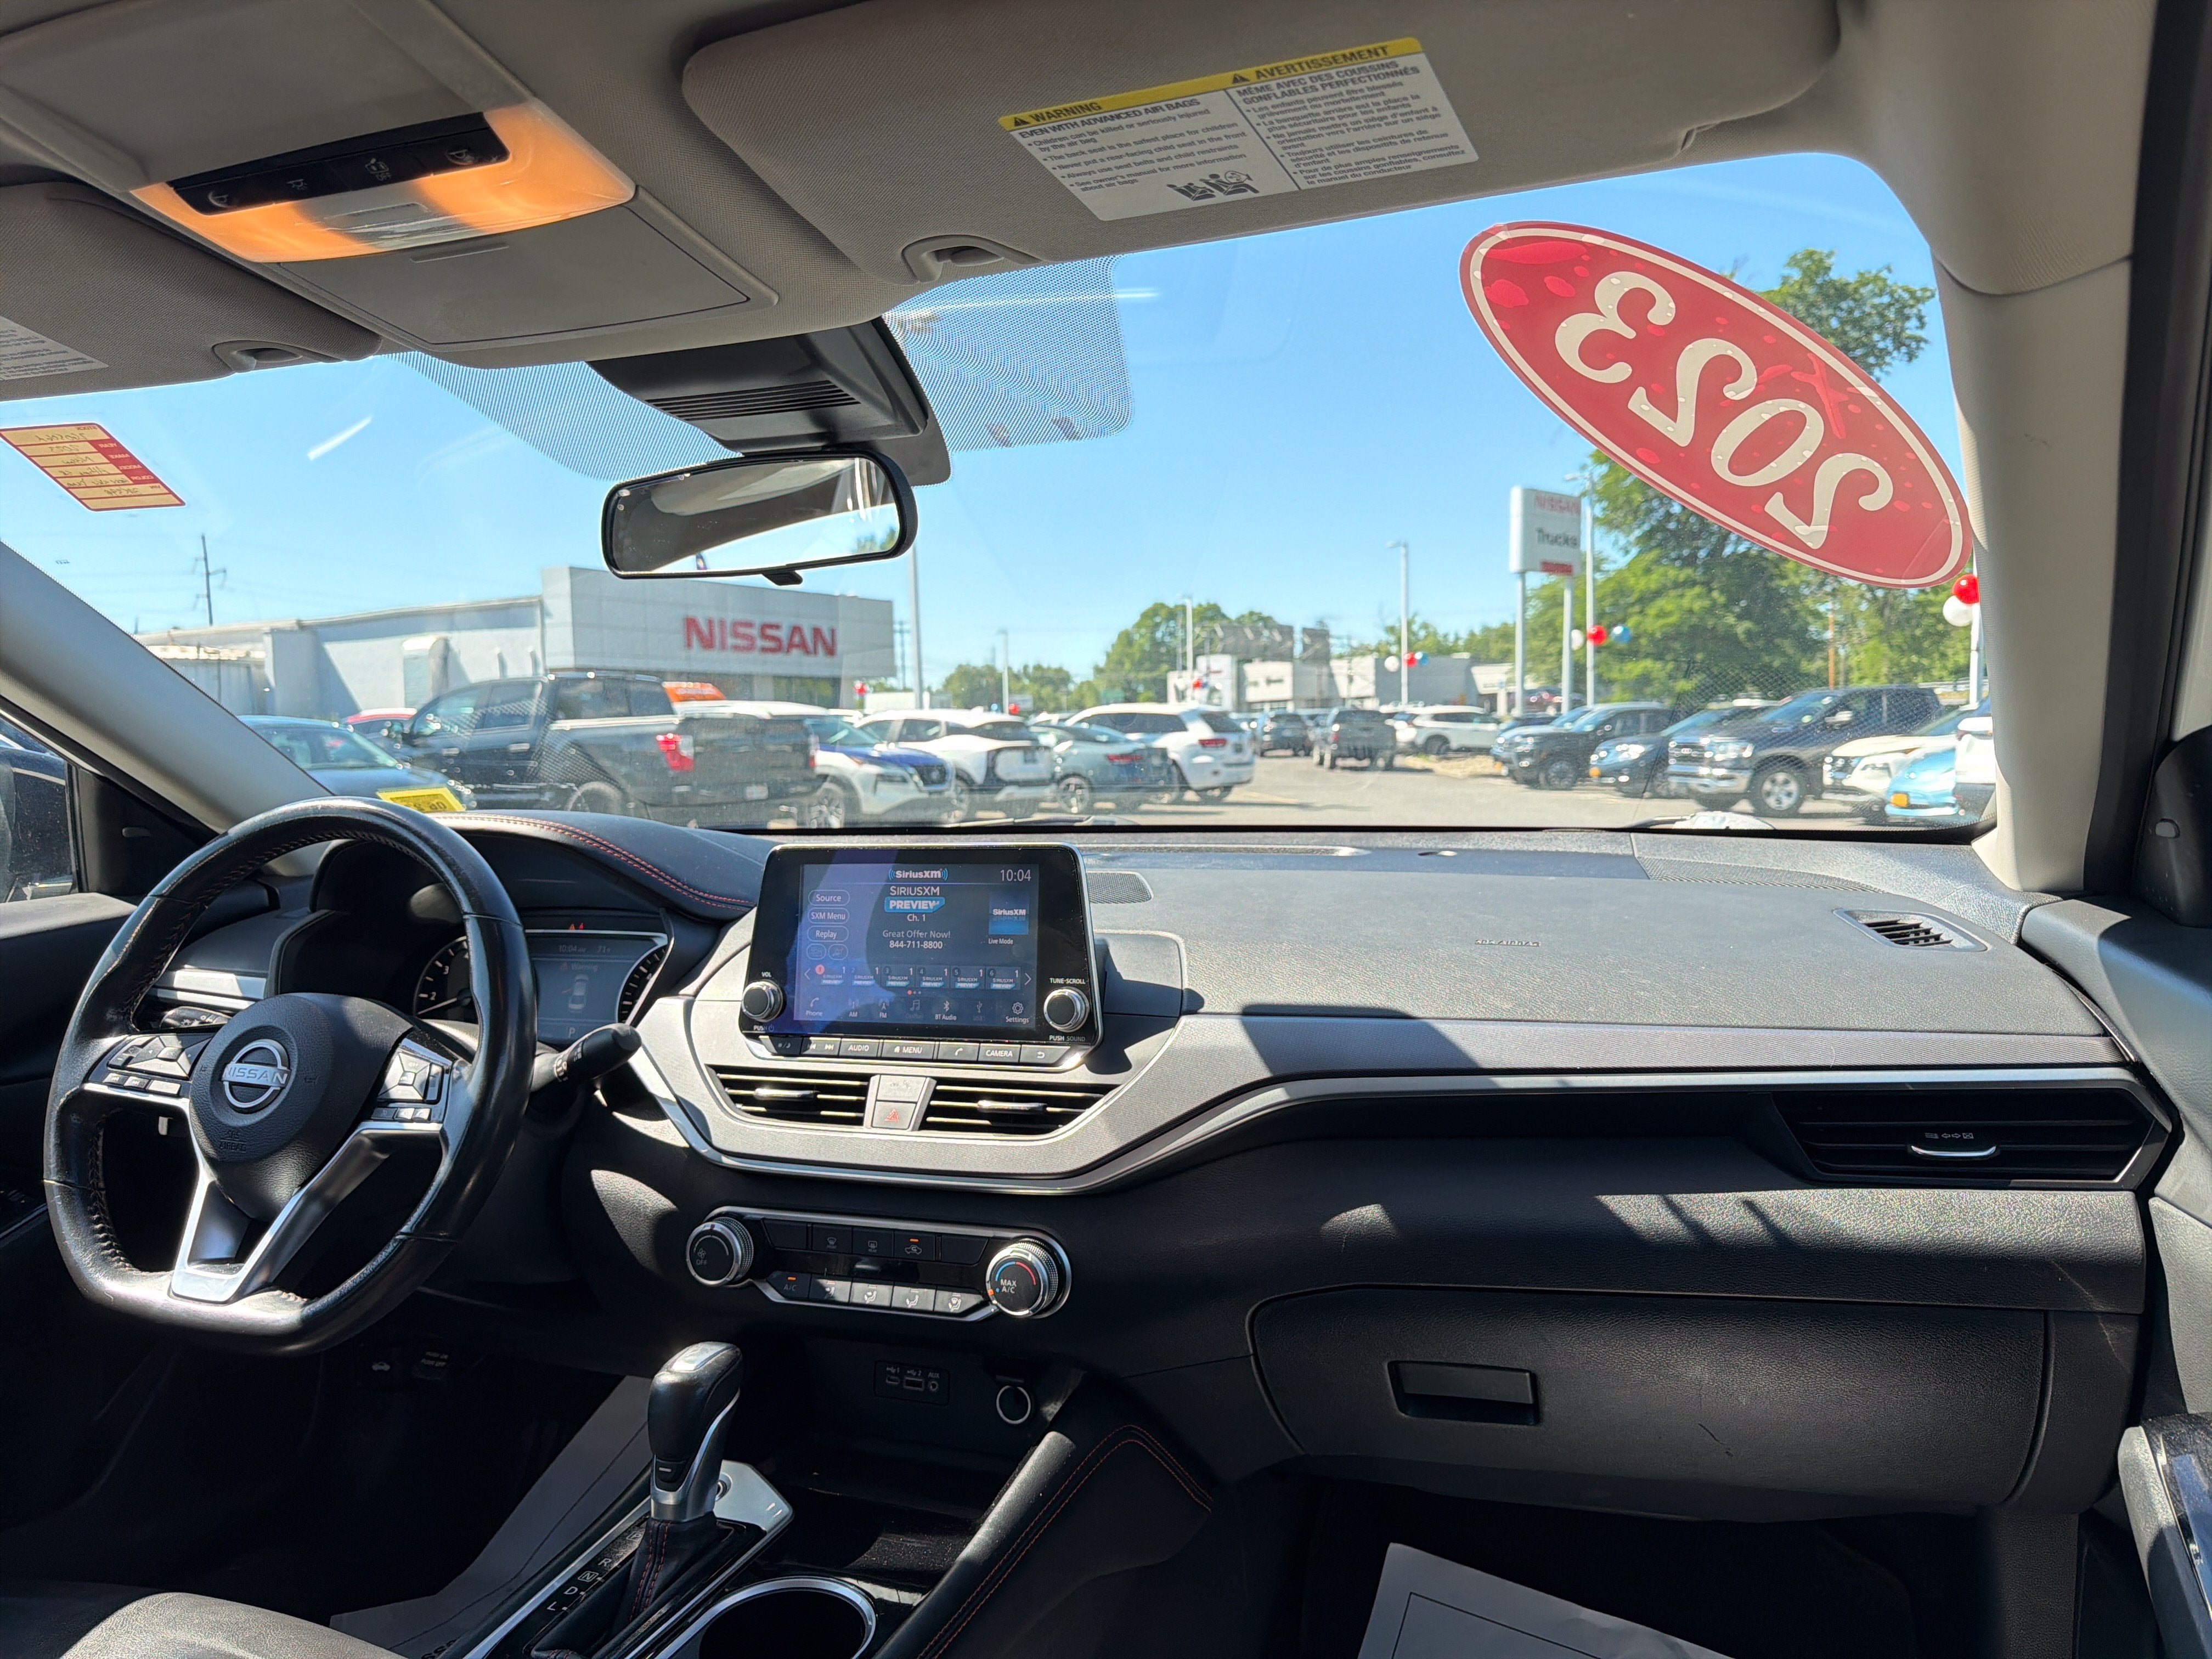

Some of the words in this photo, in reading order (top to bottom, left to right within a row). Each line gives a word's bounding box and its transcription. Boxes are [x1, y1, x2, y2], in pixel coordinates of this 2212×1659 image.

[1255, 44, 1388, 80] AVERTISSEMENT
[1236, 84, 1273, 96] MÊME
[1276, 78, 1307, 89] AVEC
[1308, 73, 1334, 83] DES
[1336, 61, 1398, 77] COUSSINS
[1243, 85, 1318, 104] GONFLABLES
[1320, 66, 1419, 89] PERFECTIONNÉS
[1030, 101, 1103, 122] WARNING
[1018, 127, 1049, 138] EVEN
[1047, 121, 1080, 132] WITH
[1080, 110, 1142, 126] ADVANCED
[1143, 105, 1165, 114] AIR
[1164, 99, 1200, 110] BAGS
[1033, 136, 1069, 145] Children
[1099, 125, 1124, 133] killed
[1136, 116, 1176, 126] seriously
[1177, 109, 1210, 119] injured
[1132, 136, 1160, 145] safest
[1161, 132, 1185, 141] place
[1201, 123, 1238, 132] children
[1106, 149, 1153, 161] rear-facing
[1223, 131, 1246, 139] front
[1197, 144, 1238, 155] restraints
[1285, 148, 1323, 157] Toujours
[1325, 142, 1354, 150] utiliser
[1372, 132, 1414, 142] ceintures
[1290, 153, 1325, 162] sécurité
[1352, 141, 1398, 152] dispositifs
[1413, 133, 1448, 142] retenue
[1092, 175, 1125, 183] owner's
[1126, 168, 1157, 177] manual
[1195, 154, 1246, 165] information
[1535, 494, 1581, 516] NISSAN
[1537, 527, 1577, 549] Trucks
[683, 616, 837, 658] NISSAN
[1000, 869, 1032, 882] 10:04
[890, 886, 940, 896] SIRIUSXM
[889, 900, 940, 910] PREVIEW
[816, 930, 837, 940] Replay
[906, 930, 927, 938] Offer
[929, 930, 951, 939] Now!
[889, 940, 943, 949] 844-711-8800
[443, 966, 449, 975] 3
[571, 963, 599, 972] Warning
[909, 967, 913, 975] 1
[430, 992, 437, 1001] 2
[568, 1027, 575, 1039] P
[985, 1049, 1013, 1058] CAMERA
[222, 1065, 288, 1085] NISSAN
[783, 1283, 797, 1293] A/C
[1000, 1279, 1017, 1288] MAX
[1001, 1285, 1015, 1294] A/C
[598, 1558, 612, 1567] R
[563, 1586, 578, 1595] D
[546, 1601, 557, 1611] L
